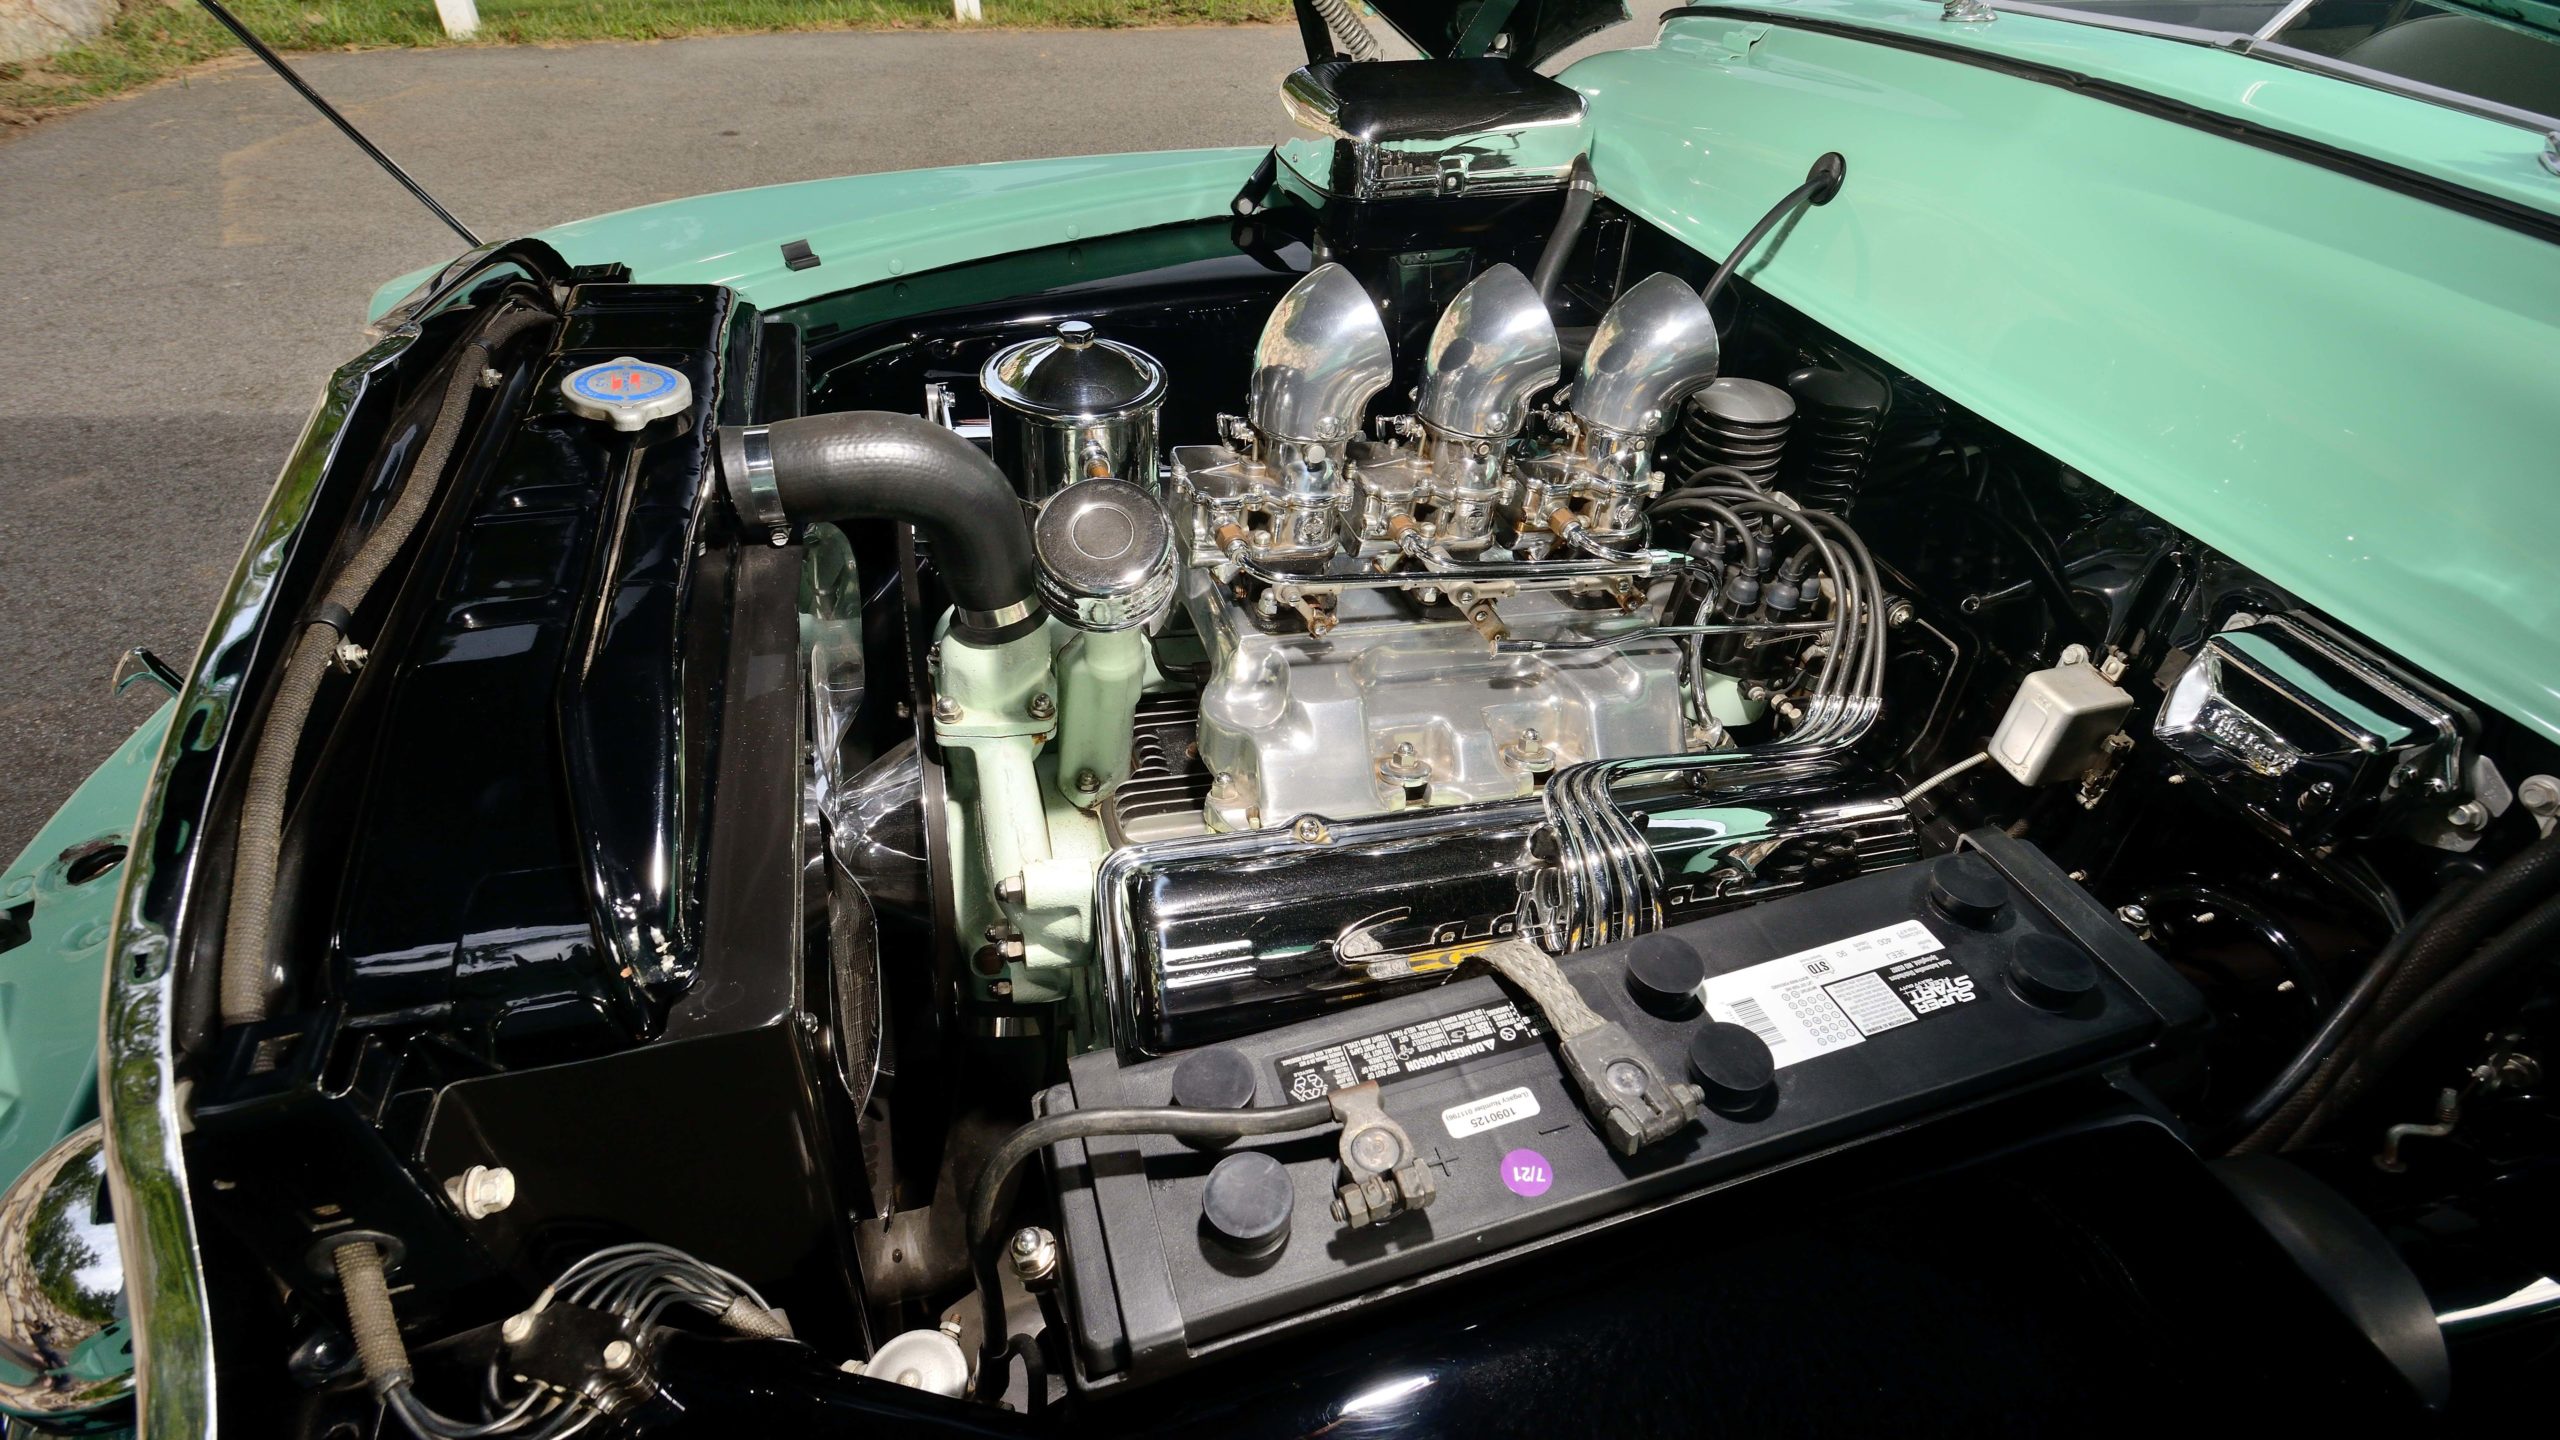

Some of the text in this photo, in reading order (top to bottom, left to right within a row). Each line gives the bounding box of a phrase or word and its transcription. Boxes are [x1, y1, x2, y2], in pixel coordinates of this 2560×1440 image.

[1808, 962, 1830, 974] STD
[1909, 974, 1974, 1005] START
[1914, 989, 1977, 1014] SUPER
[1389, 1021, 1439, 1039] MEDICAL HELP FAST.
[1361, 1038, 1371, 1046] AND
[1350, 1041, 1389, 1056] KEEP VENT CAPS
[1372, 1049, 1383, 1057] NOT
[1417, 1044, 1431, 1052] EYES
[1406, 1043, 1485, 1071] DANGER/POISON
[1369, 1062, 1386, 1072] REACH
[1387, 1066, 1400, 1075] KEEP
[1375, 1070, 1387, 1078] OUT
[1502, 1092, 1529, 1103] (Legacy
[1475, 1101, 1501, 1112] Number
[1471, 1108, 1515, 1128] 1090125
[1513, 1165, 1546, 1182] 7/21
